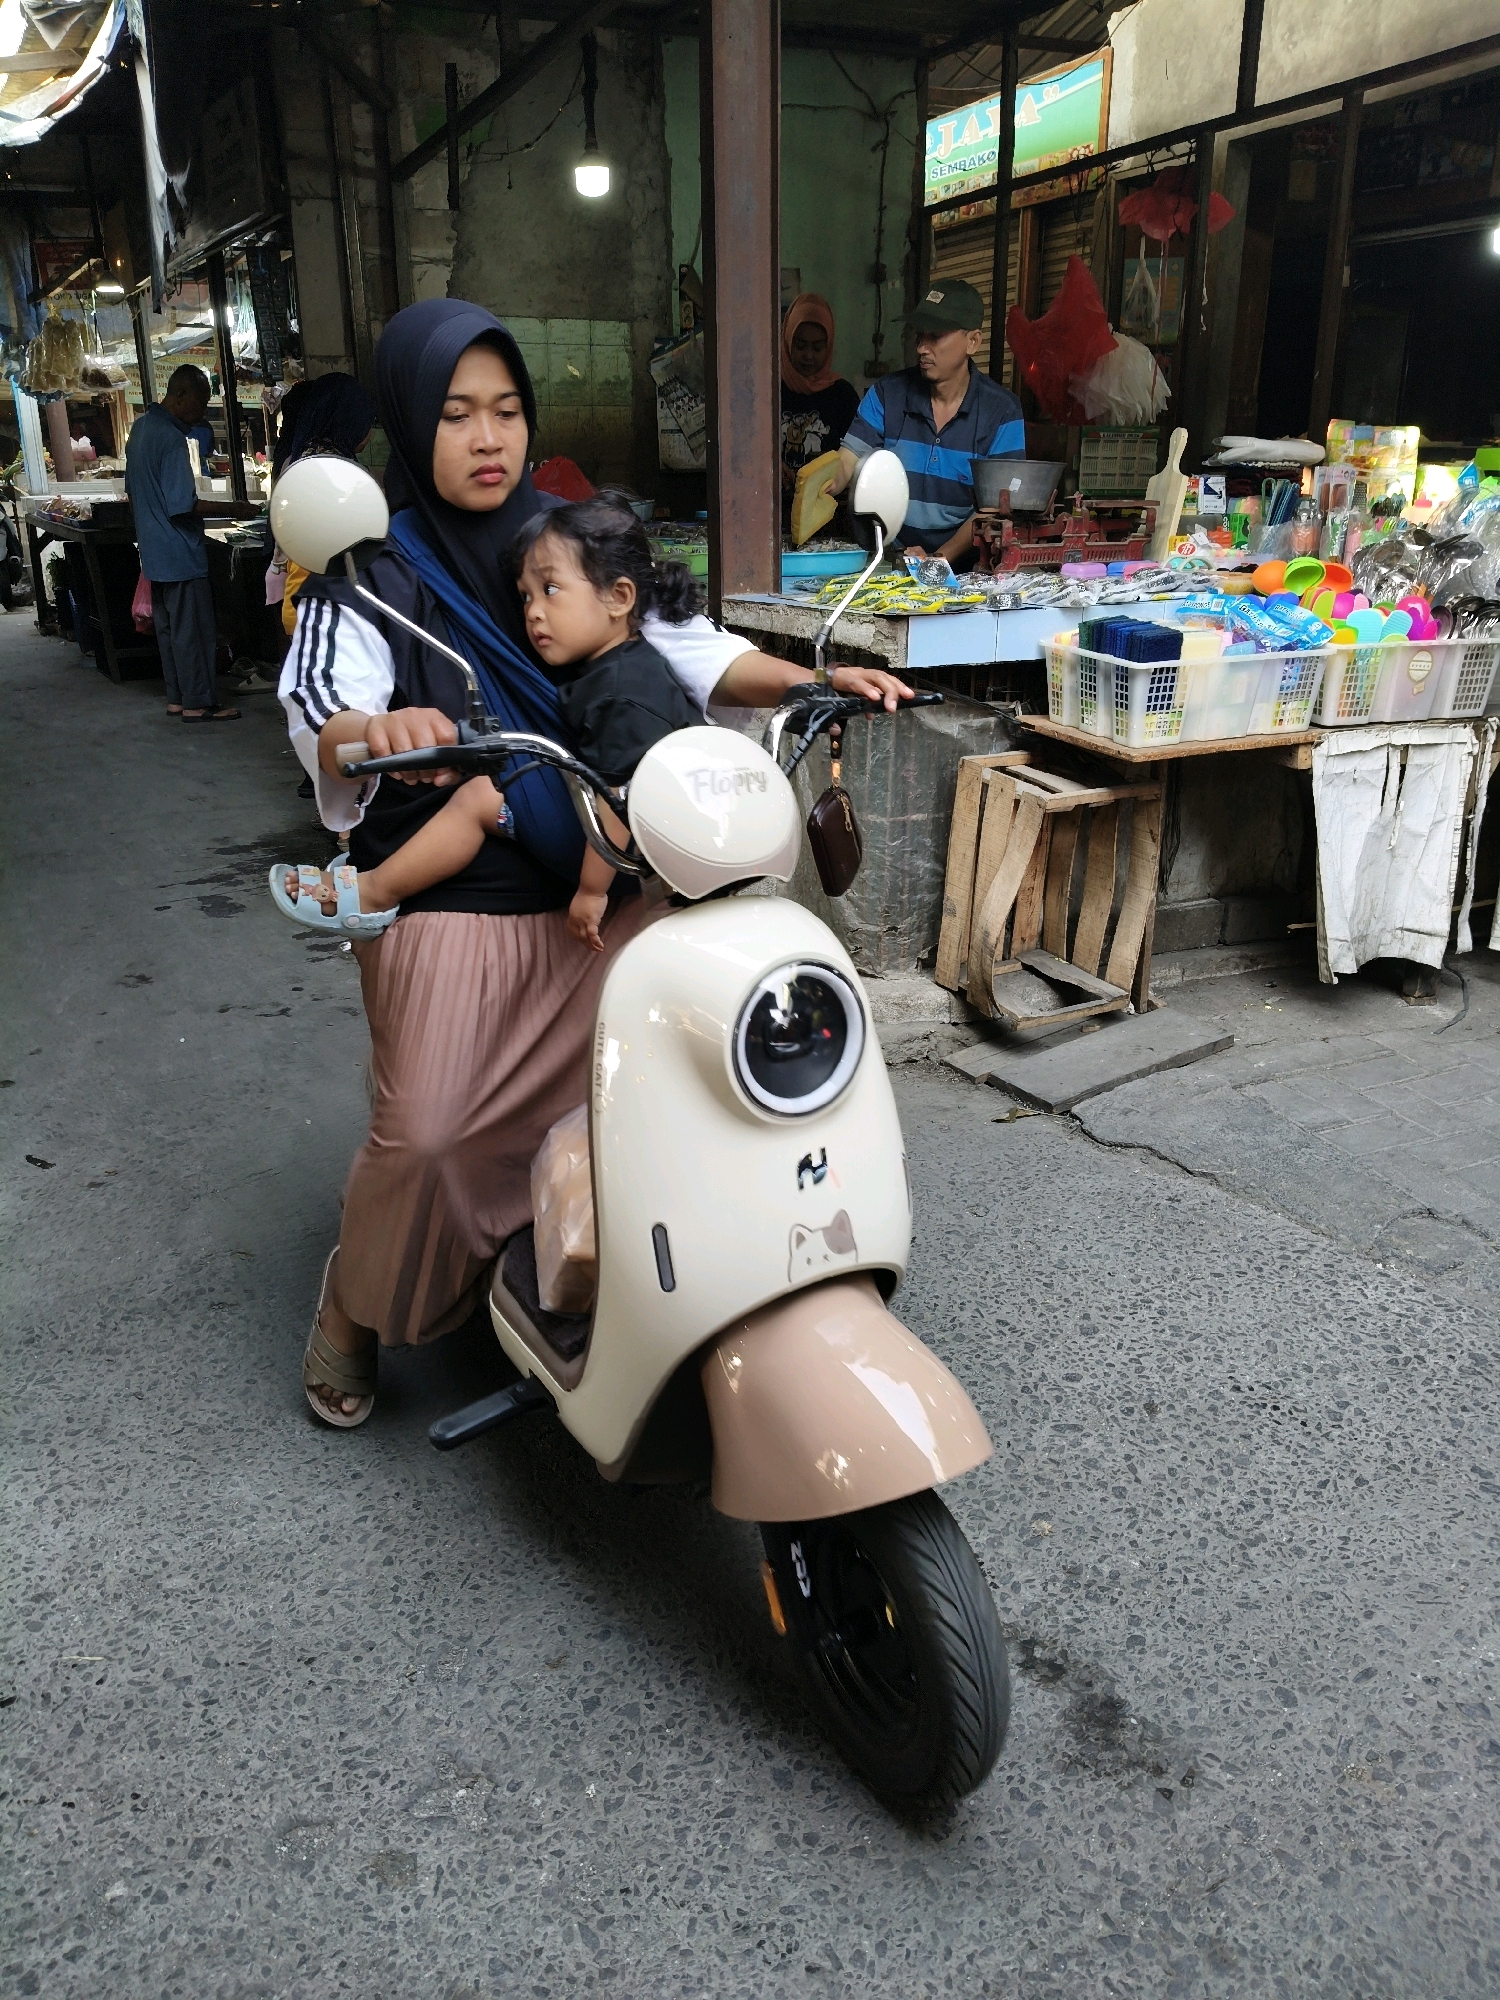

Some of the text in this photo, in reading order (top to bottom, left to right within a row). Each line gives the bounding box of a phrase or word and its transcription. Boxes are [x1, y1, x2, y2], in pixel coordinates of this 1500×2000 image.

[930, 149, 997, 180] SEMBAKO
[684, 766, 767, 803] Floppy
[594, 1021, 607, 1089] CUTE CAT
